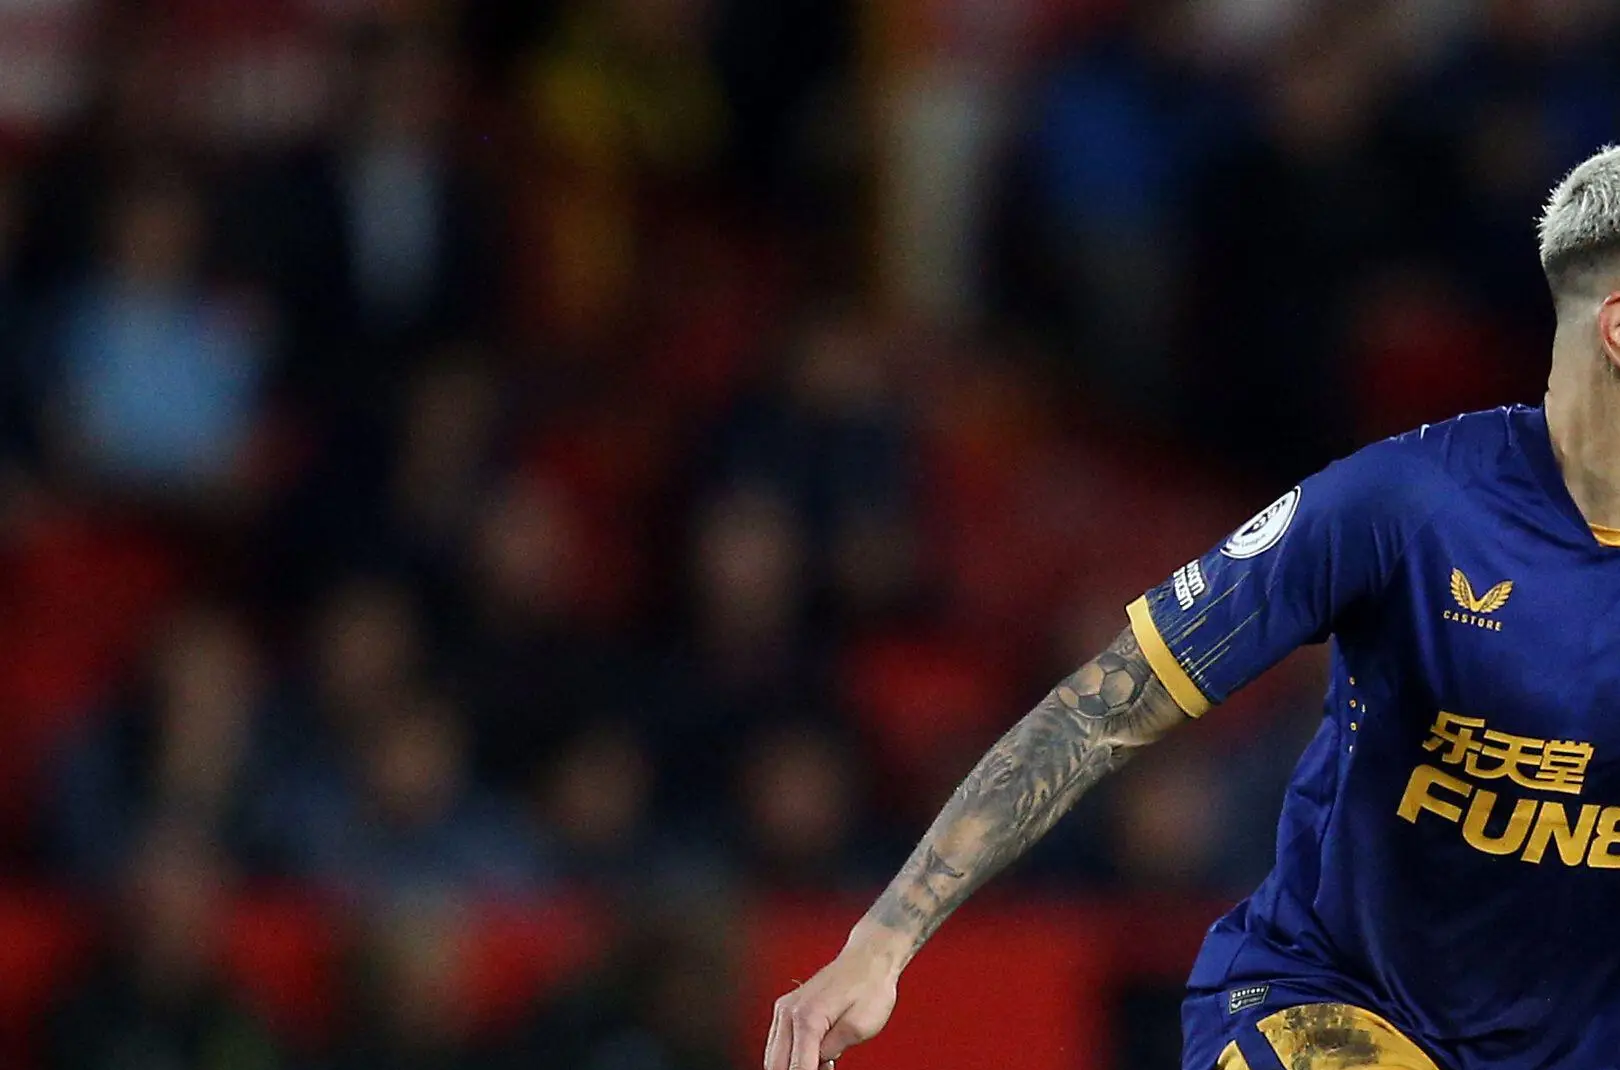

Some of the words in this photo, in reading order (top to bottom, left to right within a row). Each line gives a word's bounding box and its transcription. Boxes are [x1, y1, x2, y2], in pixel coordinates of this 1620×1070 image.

[1443, 610, 1502, 632] CASTORE
[1421, 710, 1595, 795] 乐天堂
